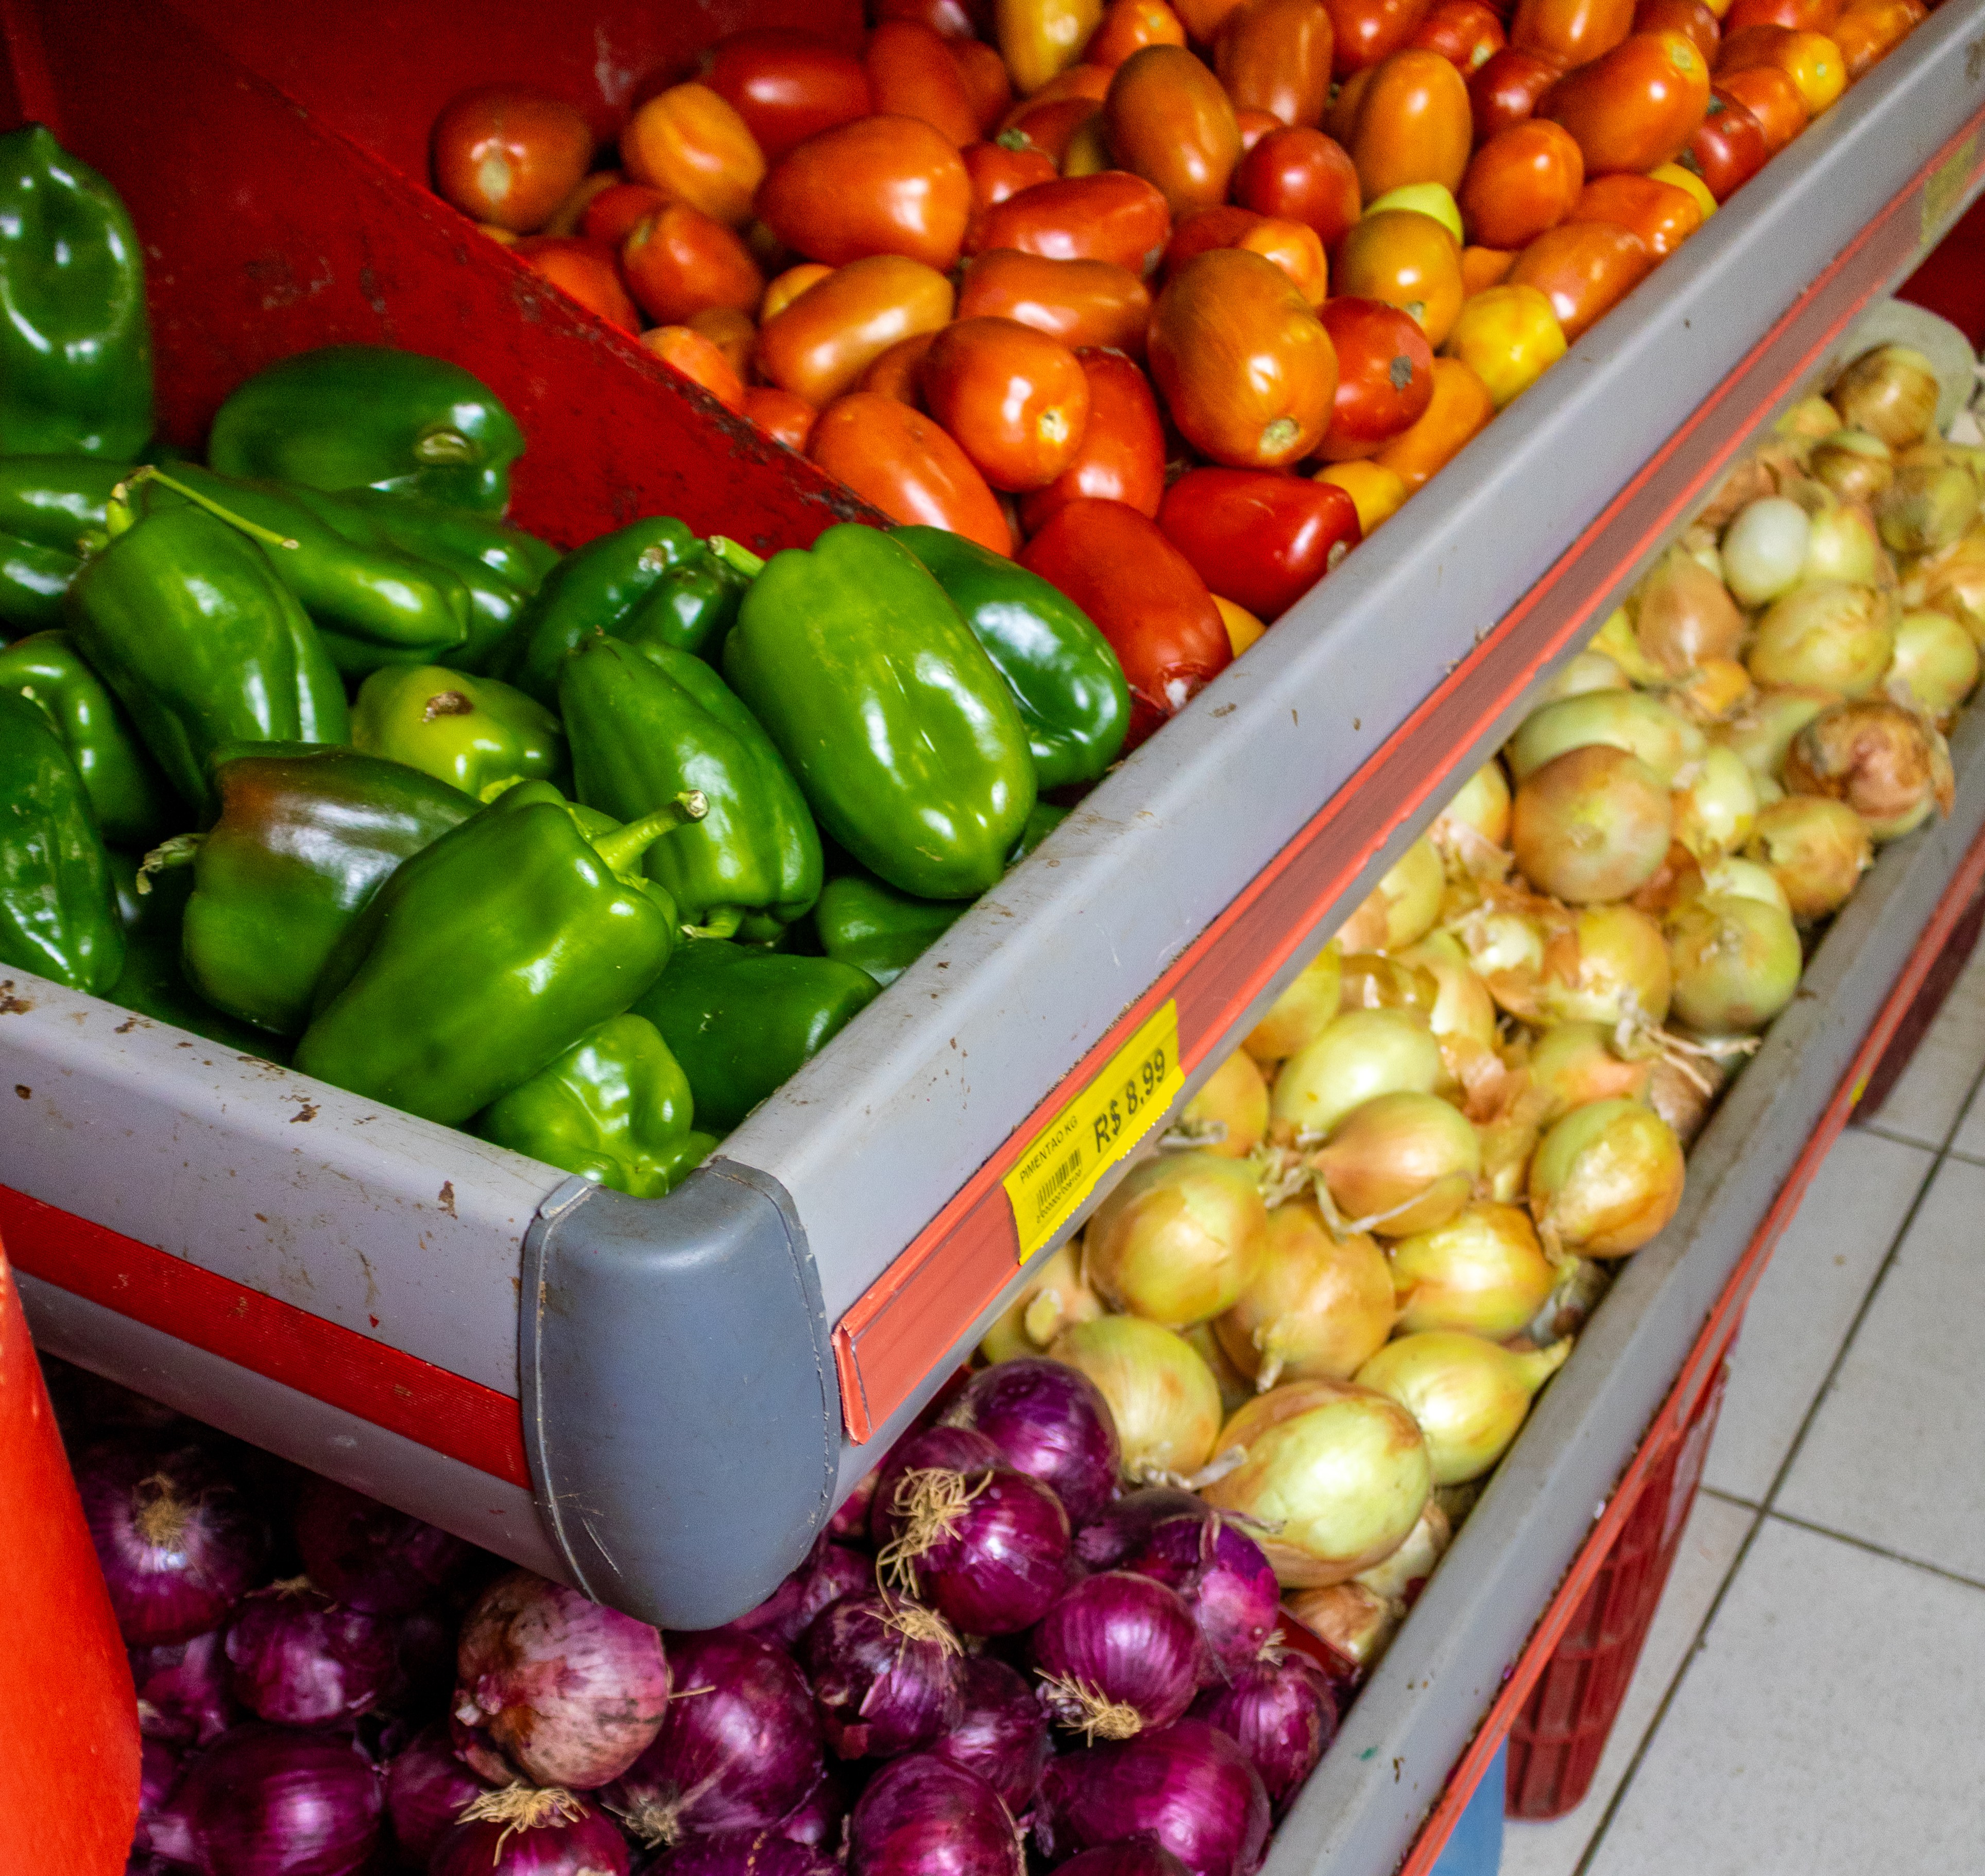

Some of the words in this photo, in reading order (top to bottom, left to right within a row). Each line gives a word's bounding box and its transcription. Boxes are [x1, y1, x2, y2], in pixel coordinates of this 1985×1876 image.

[1094, 1099, 1121, 1153] R$
[1126, 1048, 1165, 1115] 8.99
[1020, 1130, 1064, 1184] PIMENTAO
[1064, 1115, 1077, 1135] KG
